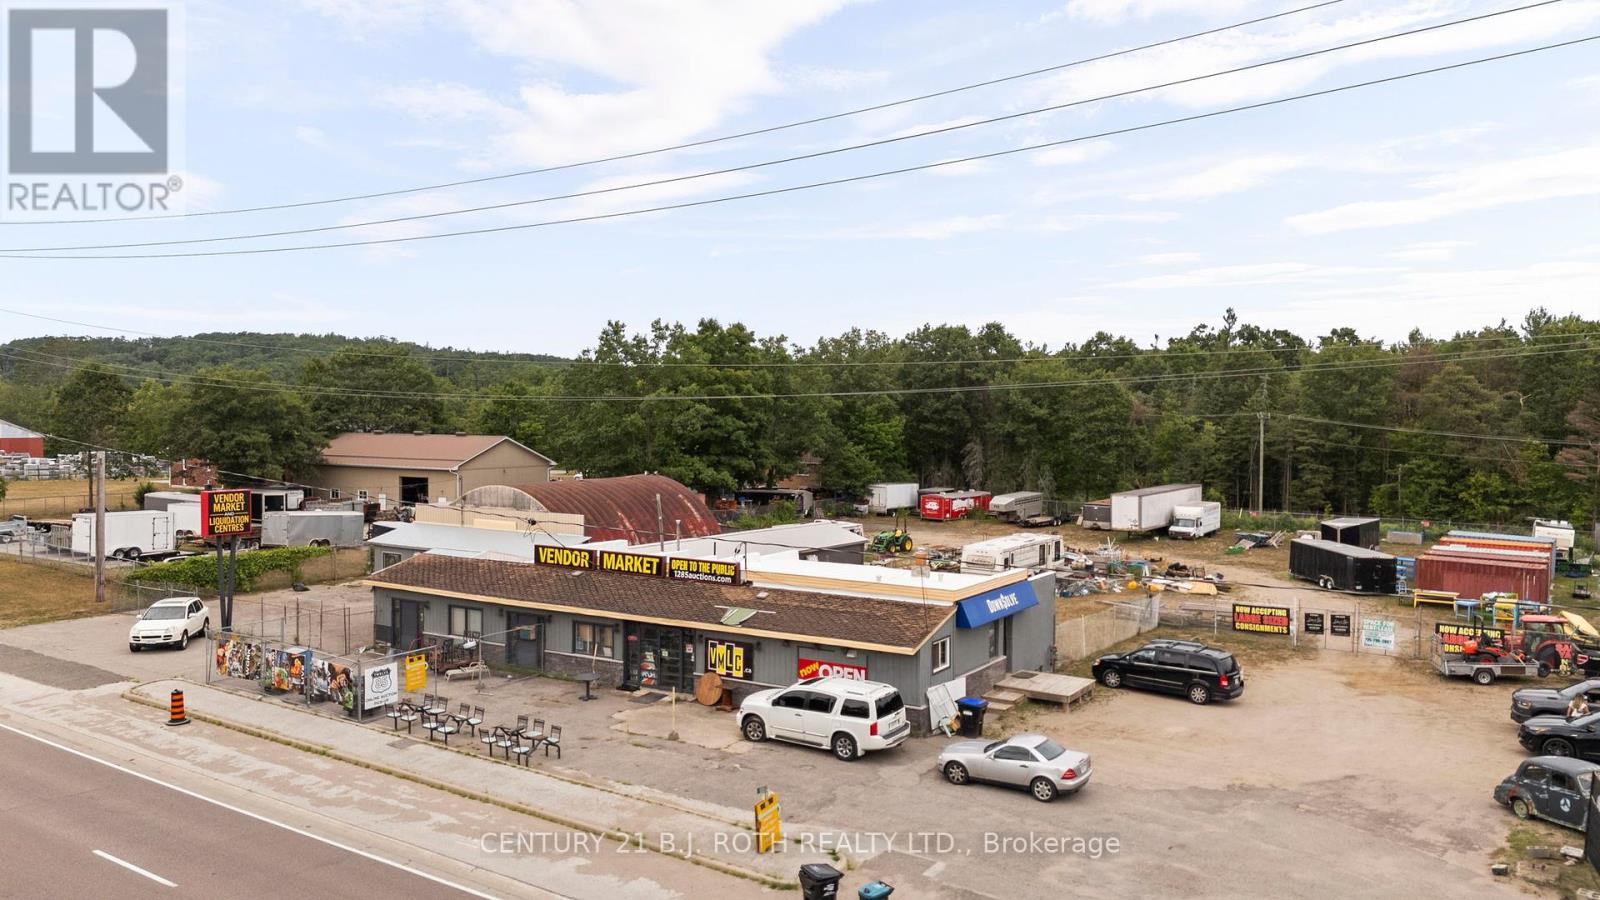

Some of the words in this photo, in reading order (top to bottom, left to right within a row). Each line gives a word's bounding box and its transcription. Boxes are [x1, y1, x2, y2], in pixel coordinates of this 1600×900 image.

[213, 493, 245, 503] VENDOR
[213, 502, 246, 513] MARKET
[209, 515, 250, 526] LIQUIDATION
[214, 524, 245, 533] CENTRES
[538, 547, 590, 568] VENDOR
[603, 553, 660, 575] MARKET
[671, 559, 688, 571] OPEN
[689, 561, 698, 572] TO
[698, 562, 711, 573] THE
[711, 563, 735, 576] PUBLIC
[674, 570, 732, 583] 1285auctions.com
[1235, 605, 1251, 614] NOW
[1251, 607, 1287, 617] ACCEPTING
[1235, 622, 1288, 634] CONSIGNMENTS
[1439, 624, 1458, 634] NOW
[709, 645, 742, 673] VMLC
[800, 662, 820, 677] now
[818, 664, 866, 682] OPEN
